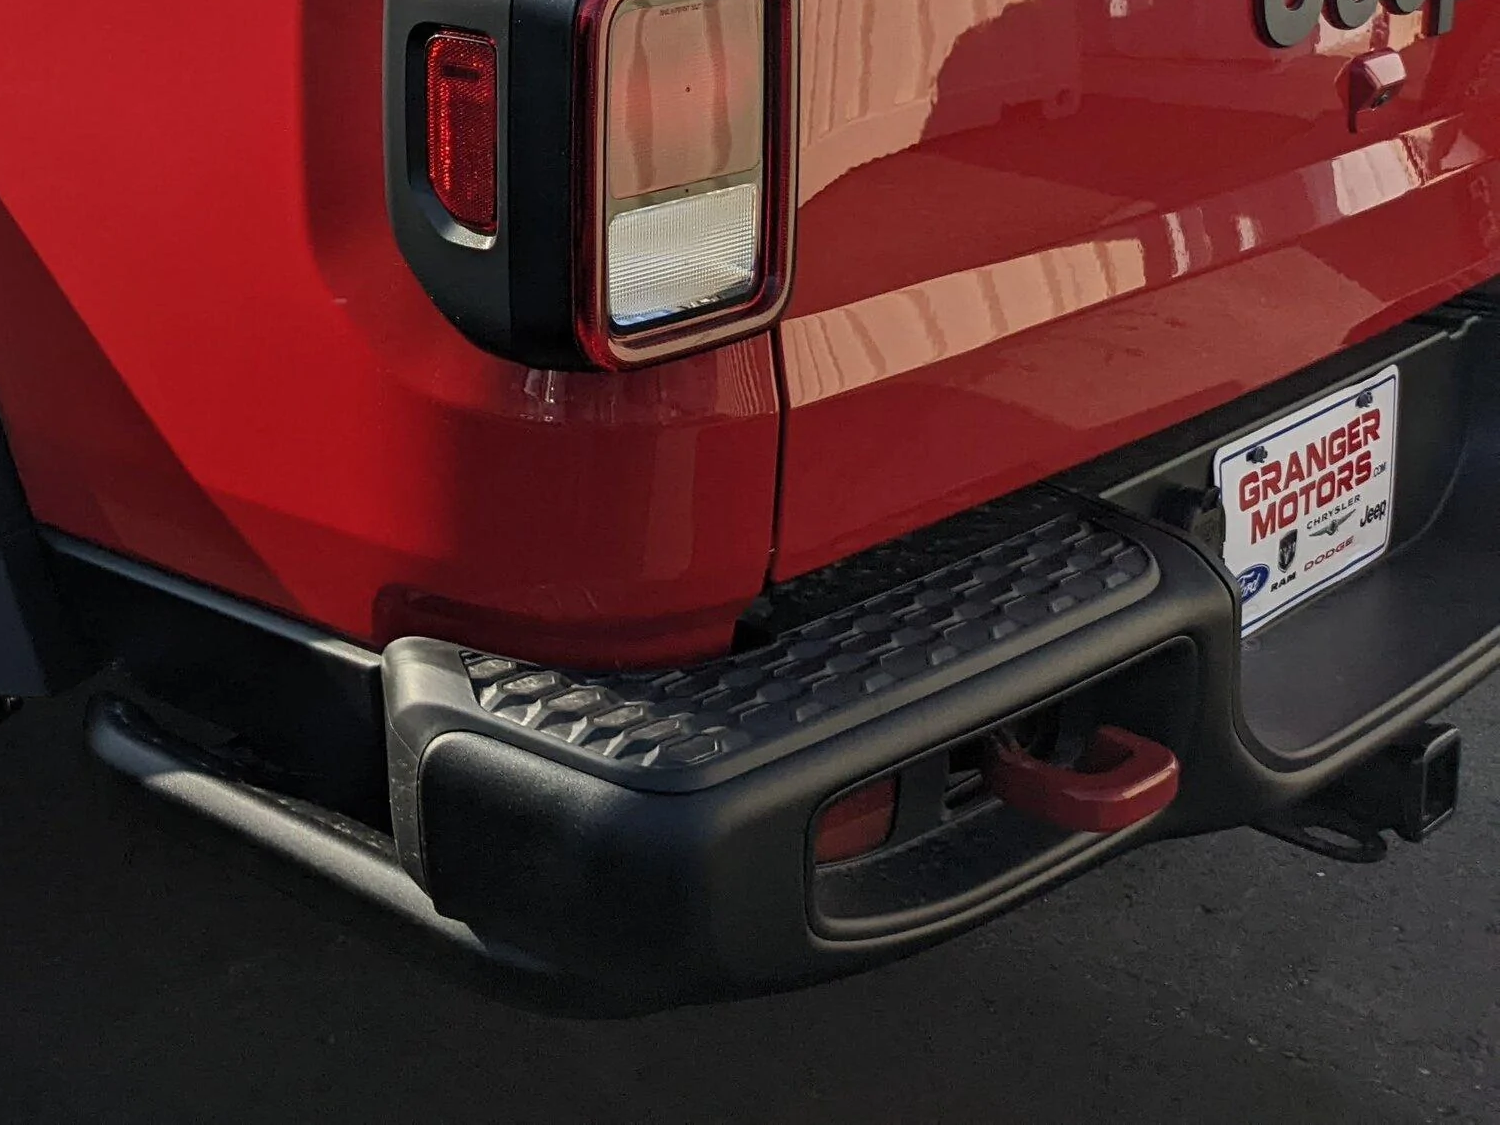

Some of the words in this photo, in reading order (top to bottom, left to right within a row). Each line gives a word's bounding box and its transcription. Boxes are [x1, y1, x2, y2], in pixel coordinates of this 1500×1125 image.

[1238, 408, 1381, 512] GRANGER
[1250, 450, 1372, 545] MOTORS
[1306, 494, 1361, 530] CHRYSLER
[1360, 499, 1387, 527] Jeep
[1303, 536, 1354, 572] DODGE
[1270, 571, 1297, 593] RAM
